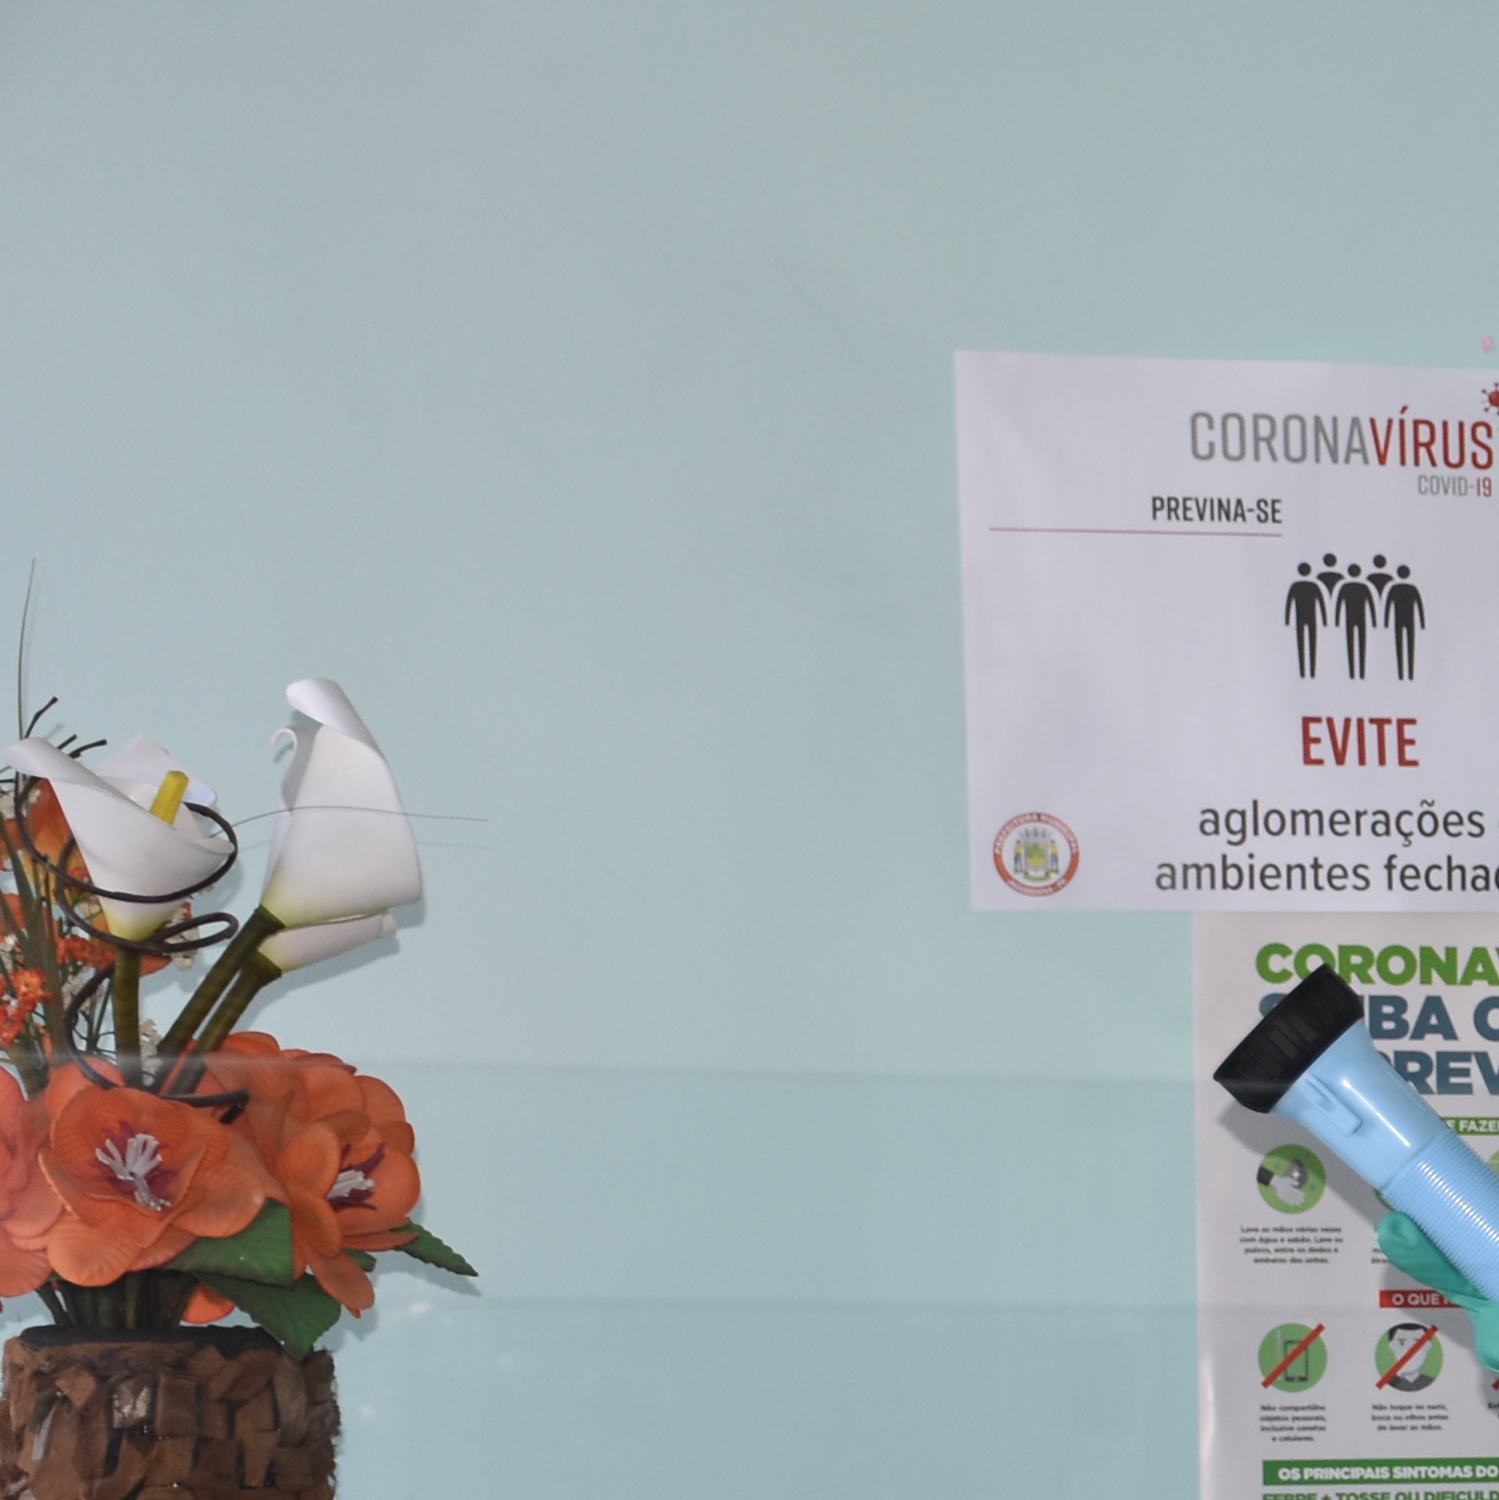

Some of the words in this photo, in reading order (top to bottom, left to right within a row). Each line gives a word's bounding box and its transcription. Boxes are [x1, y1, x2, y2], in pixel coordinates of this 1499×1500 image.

[1190, 404, 1495, 470] CORONAVÍRUS
[1417, 475, 1493, 498] COVID-19
[1151, 496, 1283, 525] PREVINA-SE
[1301, 716, 1420, 768] EVITE
[1198, 799, 1486, 852] aglomerações
[1154, 854, 1372, 893] ambientes
[1391, 1293, 1405, 1306] O
[1407, 1293, 1440, 1306] QUE
[1278, 1467, 1301, 1481] OS
[1303, 1466, 1390, 1480] PRINCIPAIS
[1392, 1465, 1473, 1479] SINTOMAS
[1475, 1465, 1499, 1478] DO
